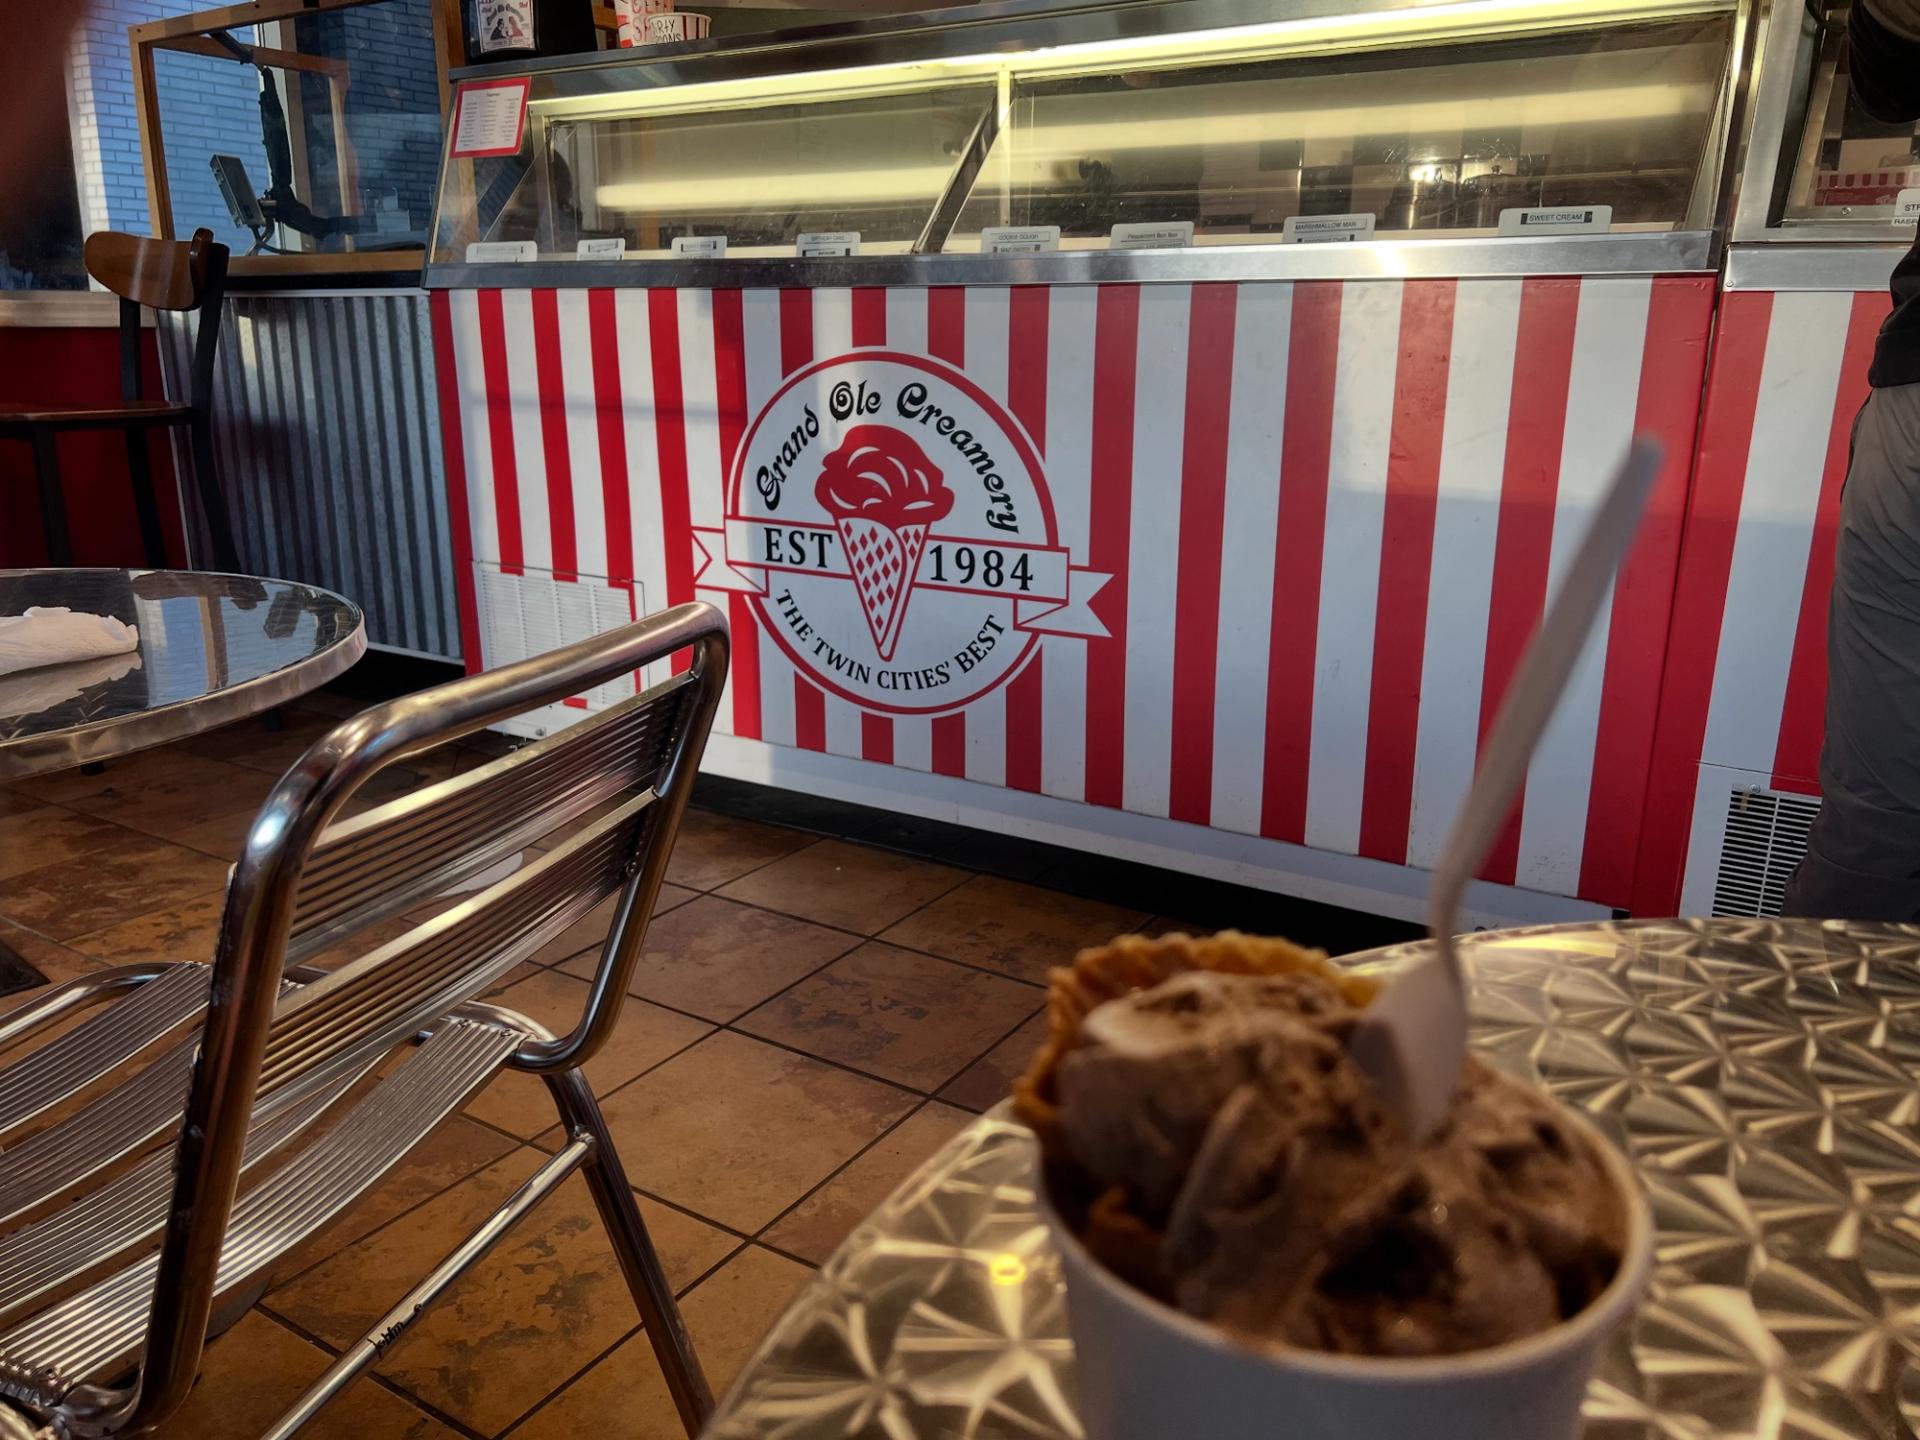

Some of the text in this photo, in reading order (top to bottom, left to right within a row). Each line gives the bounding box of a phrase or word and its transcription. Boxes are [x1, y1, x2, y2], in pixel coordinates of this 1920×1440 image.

[1529, 213, 1583, 222] SWEET CREAM
[756, 379, 1019, 534] Grand Ole Creamery
[763, 527, 1034, 591] EST 1984
[775, 589, 1006, 691] THE TWIN CITIES' BEST
